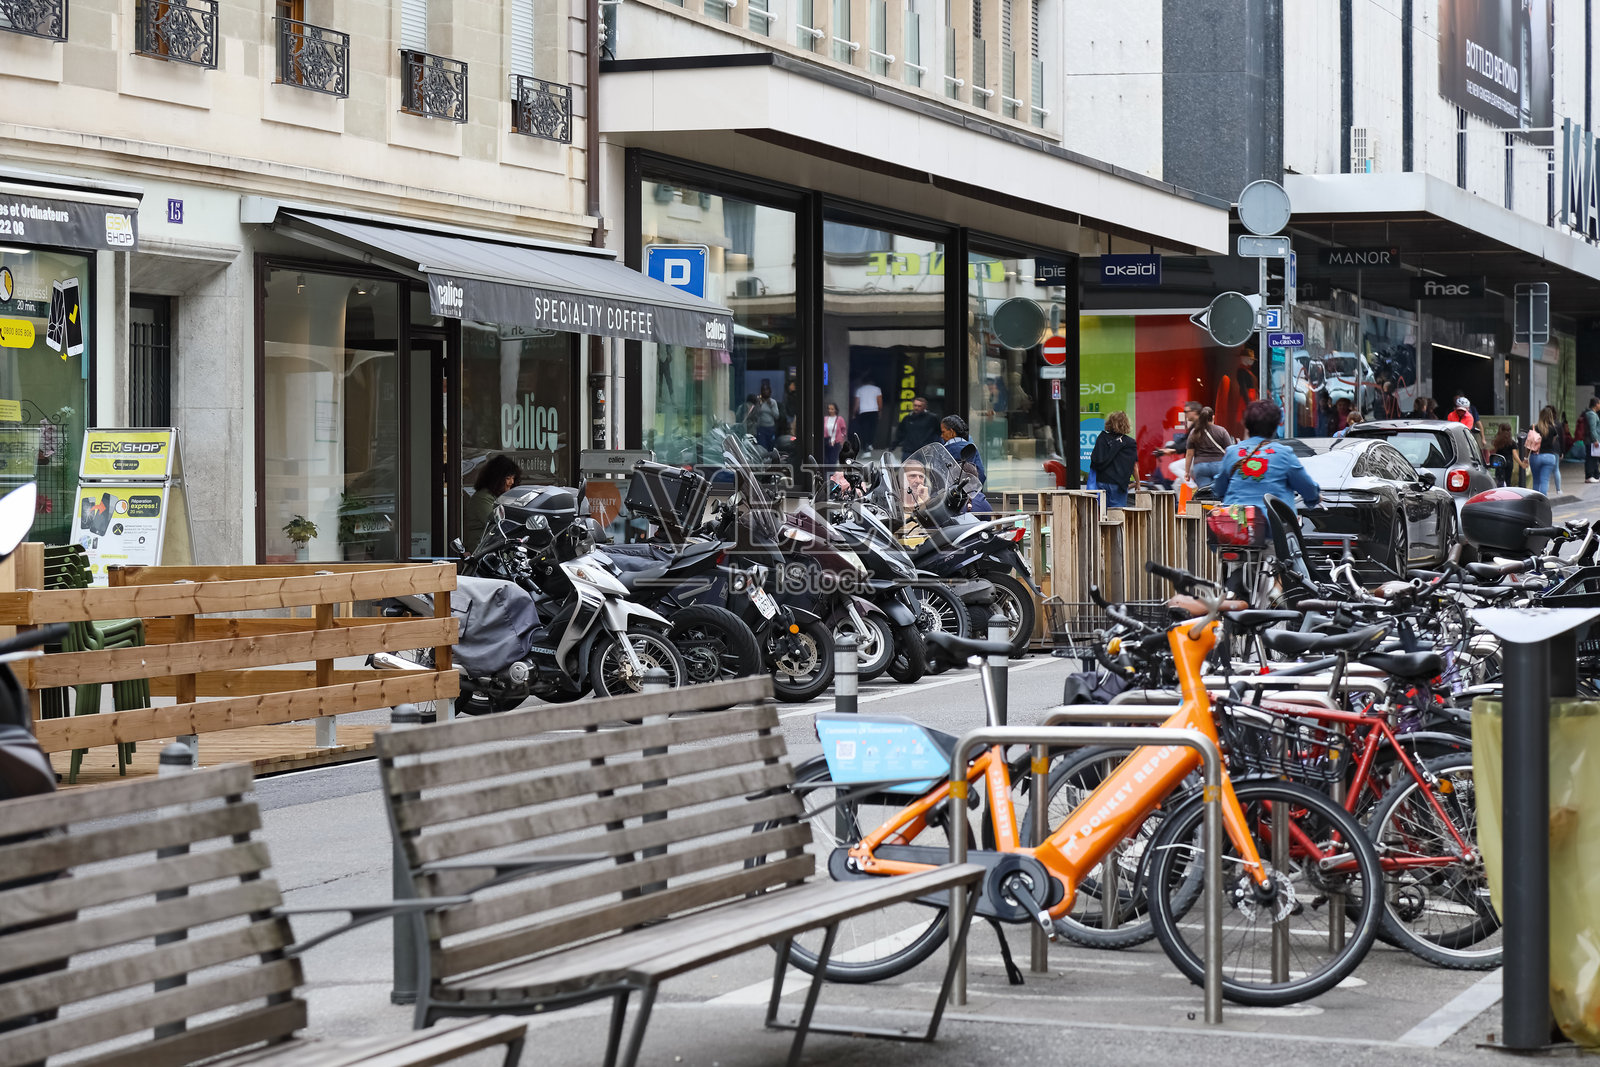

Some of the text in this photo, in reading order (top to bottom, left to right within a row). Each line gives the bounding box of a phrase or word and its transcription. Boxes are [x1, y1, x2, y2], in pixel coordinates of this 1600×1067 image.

[1465, 38, 1518, 94] BOTTLED BEYOND
[10, 205, 20, 218] et
[21, 203, 69, 223] Ordinateurs
[170, 201, 181, 221] 15
[13, 221, 25, 235] 08
[106, 215, 131, 231] GSM
[107, 232, 132, 243] SHOP
[1329, 251, 1390, 265] MANOR
[437, 280, 464, 308] calico
[1424, 281, 1470, 295] fnac
[17, 300, 24, 310] 20
[534, 297, 653, 335] SPECIALTY COFFEE
[706, 318, 726, 341] calico
[501, 392, 558, 453] calico
[608, 456, 625, 464] calico
[1080, 782, 1133, 837] DONKEY
